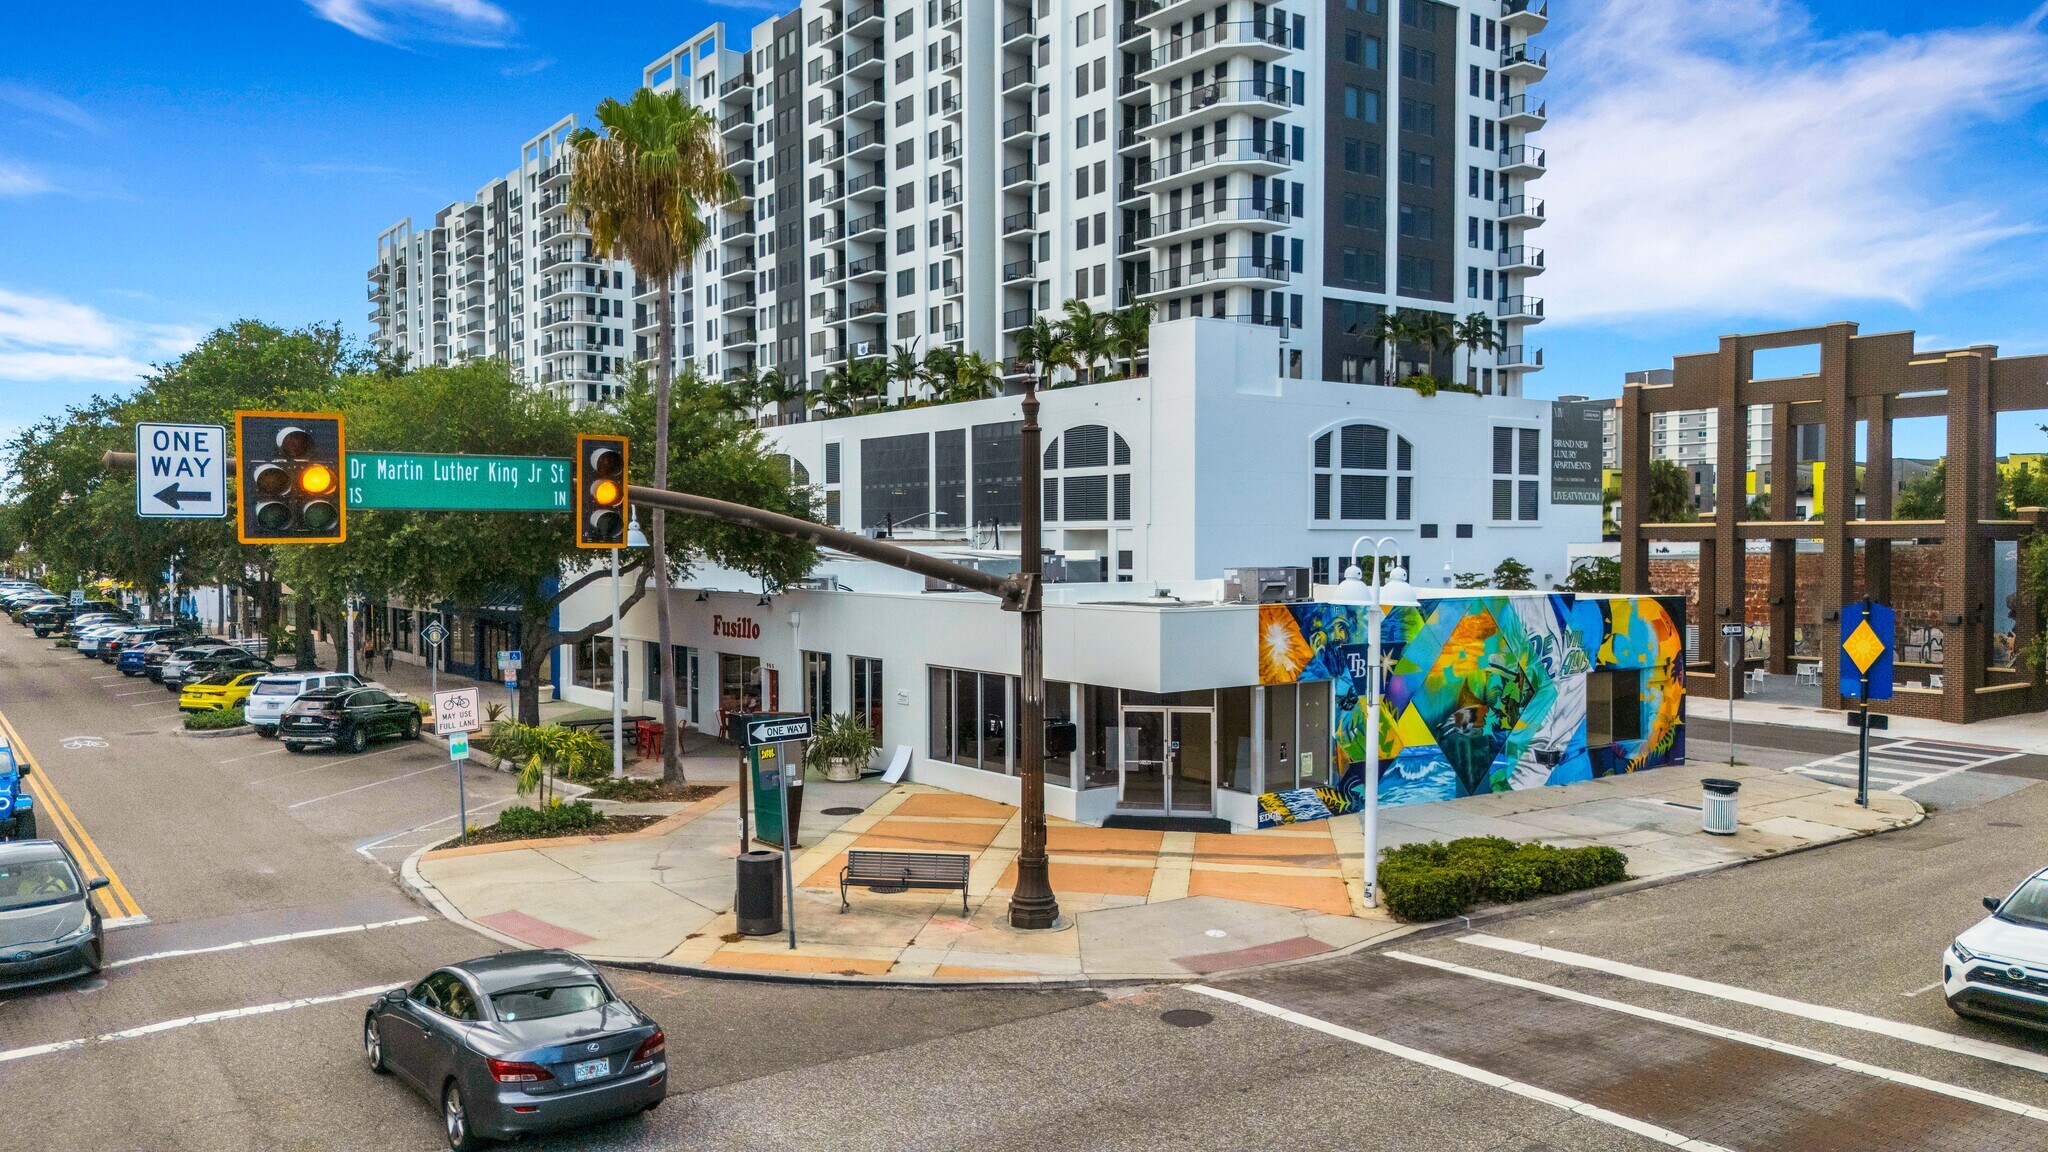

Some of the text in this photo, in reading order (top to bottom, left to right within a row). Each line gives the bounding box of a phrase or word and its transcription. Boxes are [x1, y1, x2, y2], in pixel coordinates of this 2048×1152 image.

[153, 430, 209, 452] ONE
[1553, 440, 1589, 449] BRAND NEW
[1553, 450, 1577, 459] LUXURY
[151, 456, 211, 477] WAY
[351, 459, 564, 488] Dr Martin Luther King Jr St
[1553, 462, 1591, 470] APARTMENTS
[349, 487, 362, 503] 1S
[554, 491, 566, 506] 1N
[713, 615, 760, 639] Fusillo
[1347, 653, 1366, 678] TB
[460, 710, 472, 718] USE
[460, 719, 476, 727] LANE
[766, 724, 804, 736] ONE WAY
